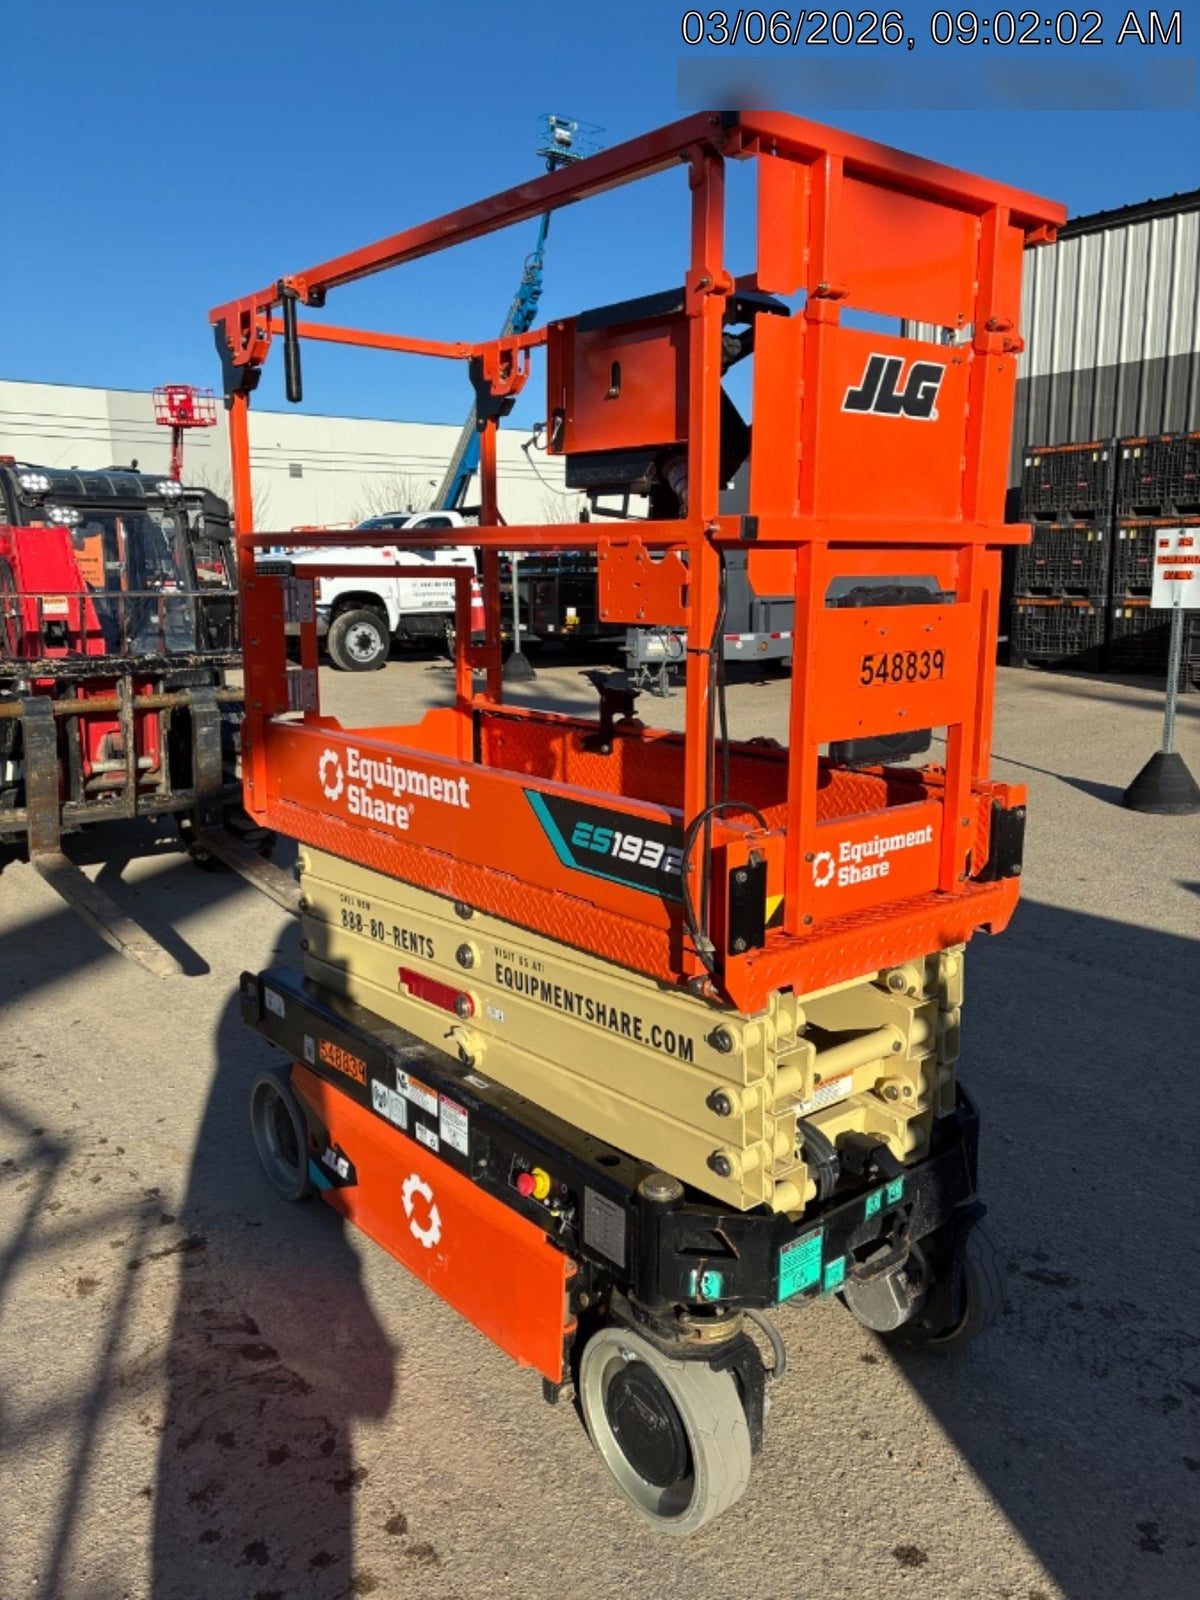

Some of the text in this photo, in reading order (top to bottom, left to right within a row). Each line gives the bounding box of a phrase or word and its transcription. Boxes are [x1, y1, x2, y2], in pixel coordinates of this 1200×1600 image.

[841, 353, 946, 421] JLG
[860, 649, 944, 685] 548839
[346, 747, 470, 809] Equipment
[347, 784, 410, 830] Share
[838, 824, 933, 863] Equipment
[837, 860, 890, 887] Share
[340, 908, 435, 959] 888-80-RENTS
[494, 947, 545, 973] VISIT US AT:
[494, 962, 695, 1063] EQUIPMENTSHARE.COM
